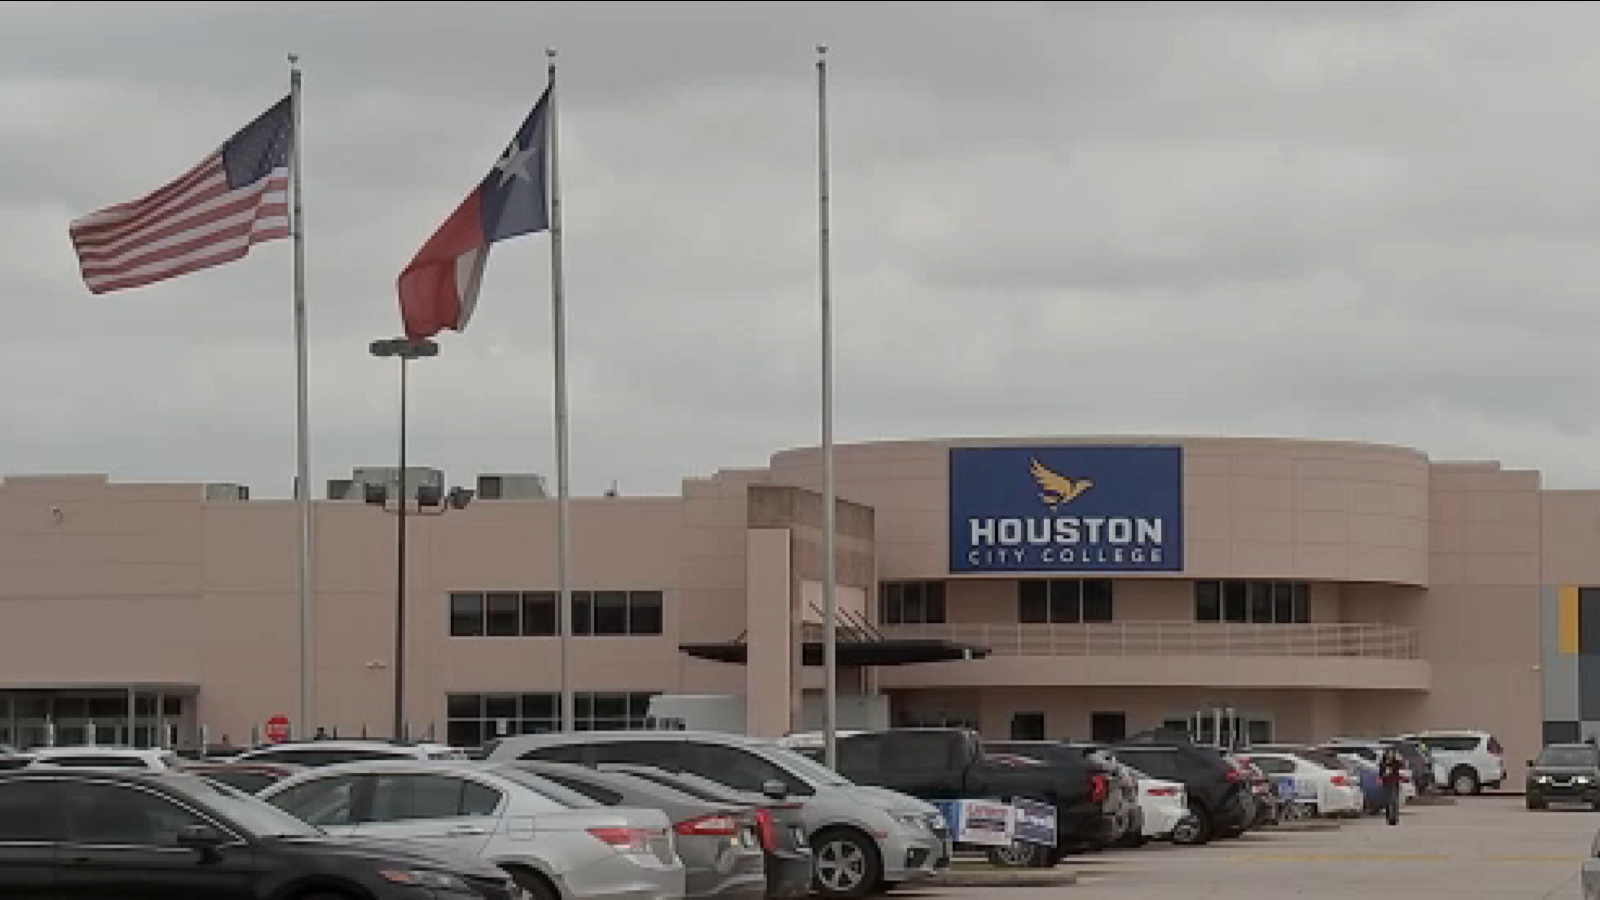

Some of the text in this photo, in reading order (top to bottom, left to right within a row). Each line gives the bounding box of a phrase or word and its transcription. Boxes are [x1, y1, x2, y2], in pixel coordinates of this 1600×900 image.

[969, 518, 1162, 545] HOUSTON
[968, 548, 1162, 565] CITY COLLEGE
